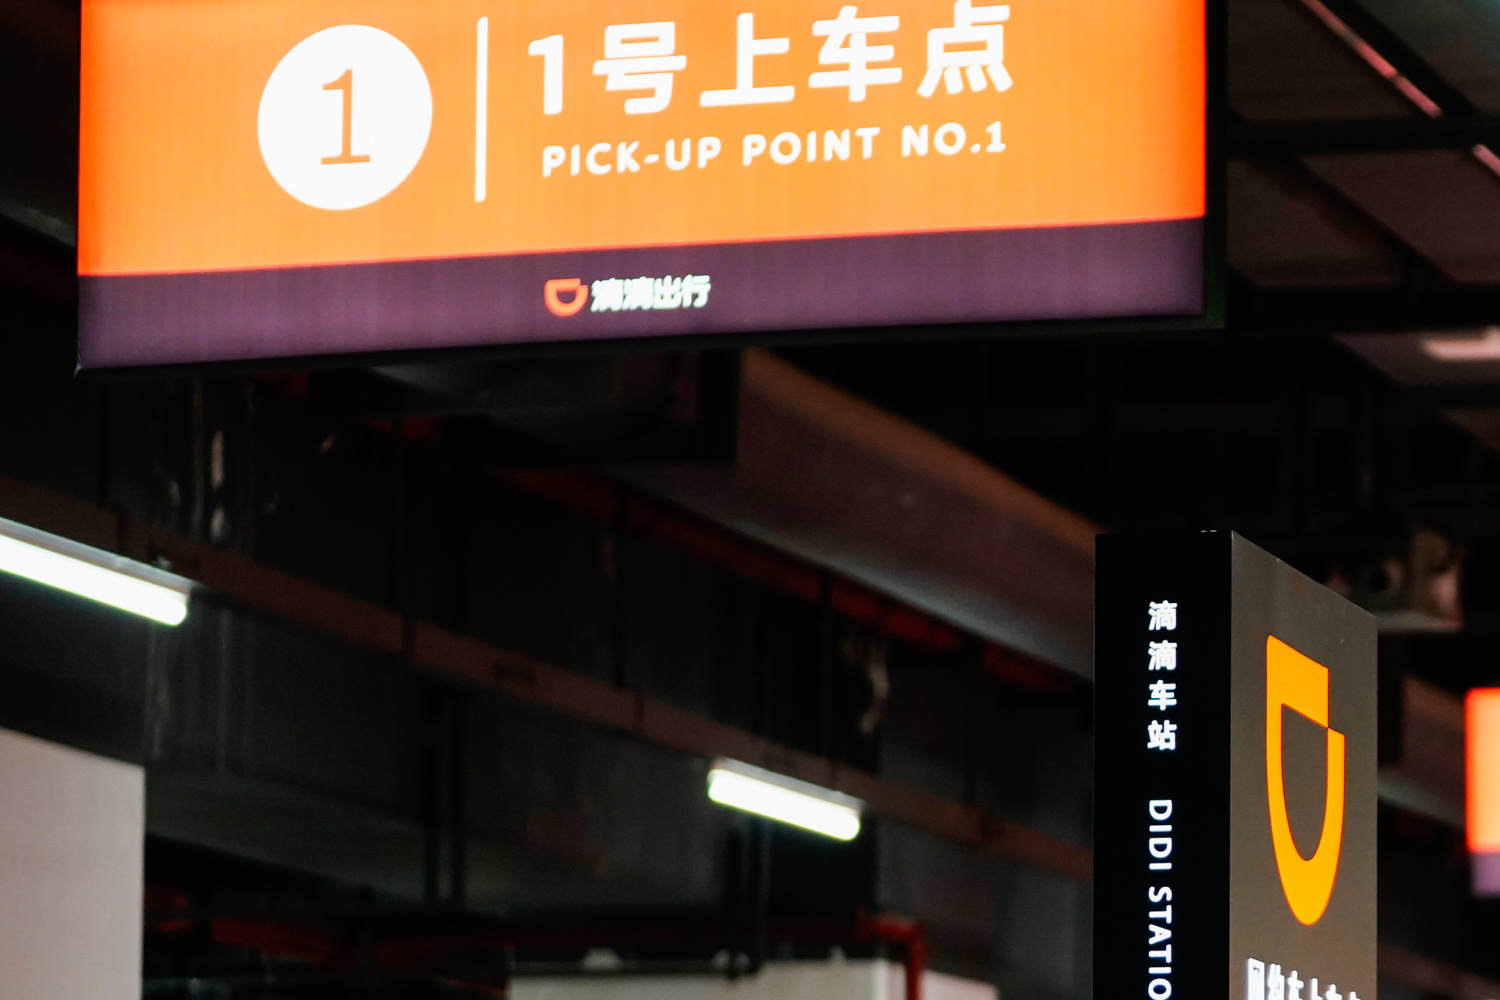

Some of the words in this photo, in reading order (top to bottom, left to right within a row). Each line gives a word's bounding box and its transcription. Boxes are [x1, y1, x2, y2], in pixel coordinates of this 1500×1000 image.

[528, 0, 1013, 115] 1号上车点
[318, 67, 371, 167] 1
[542, 136, 722, 178] PICK-UP
[742, 126, 881, 166] POINT
[901, 120, 1006, 157] NO.1
[1147, 600, 1178, 751] 滴滴车站
[1148, 799, 1173, 870] DIDI
